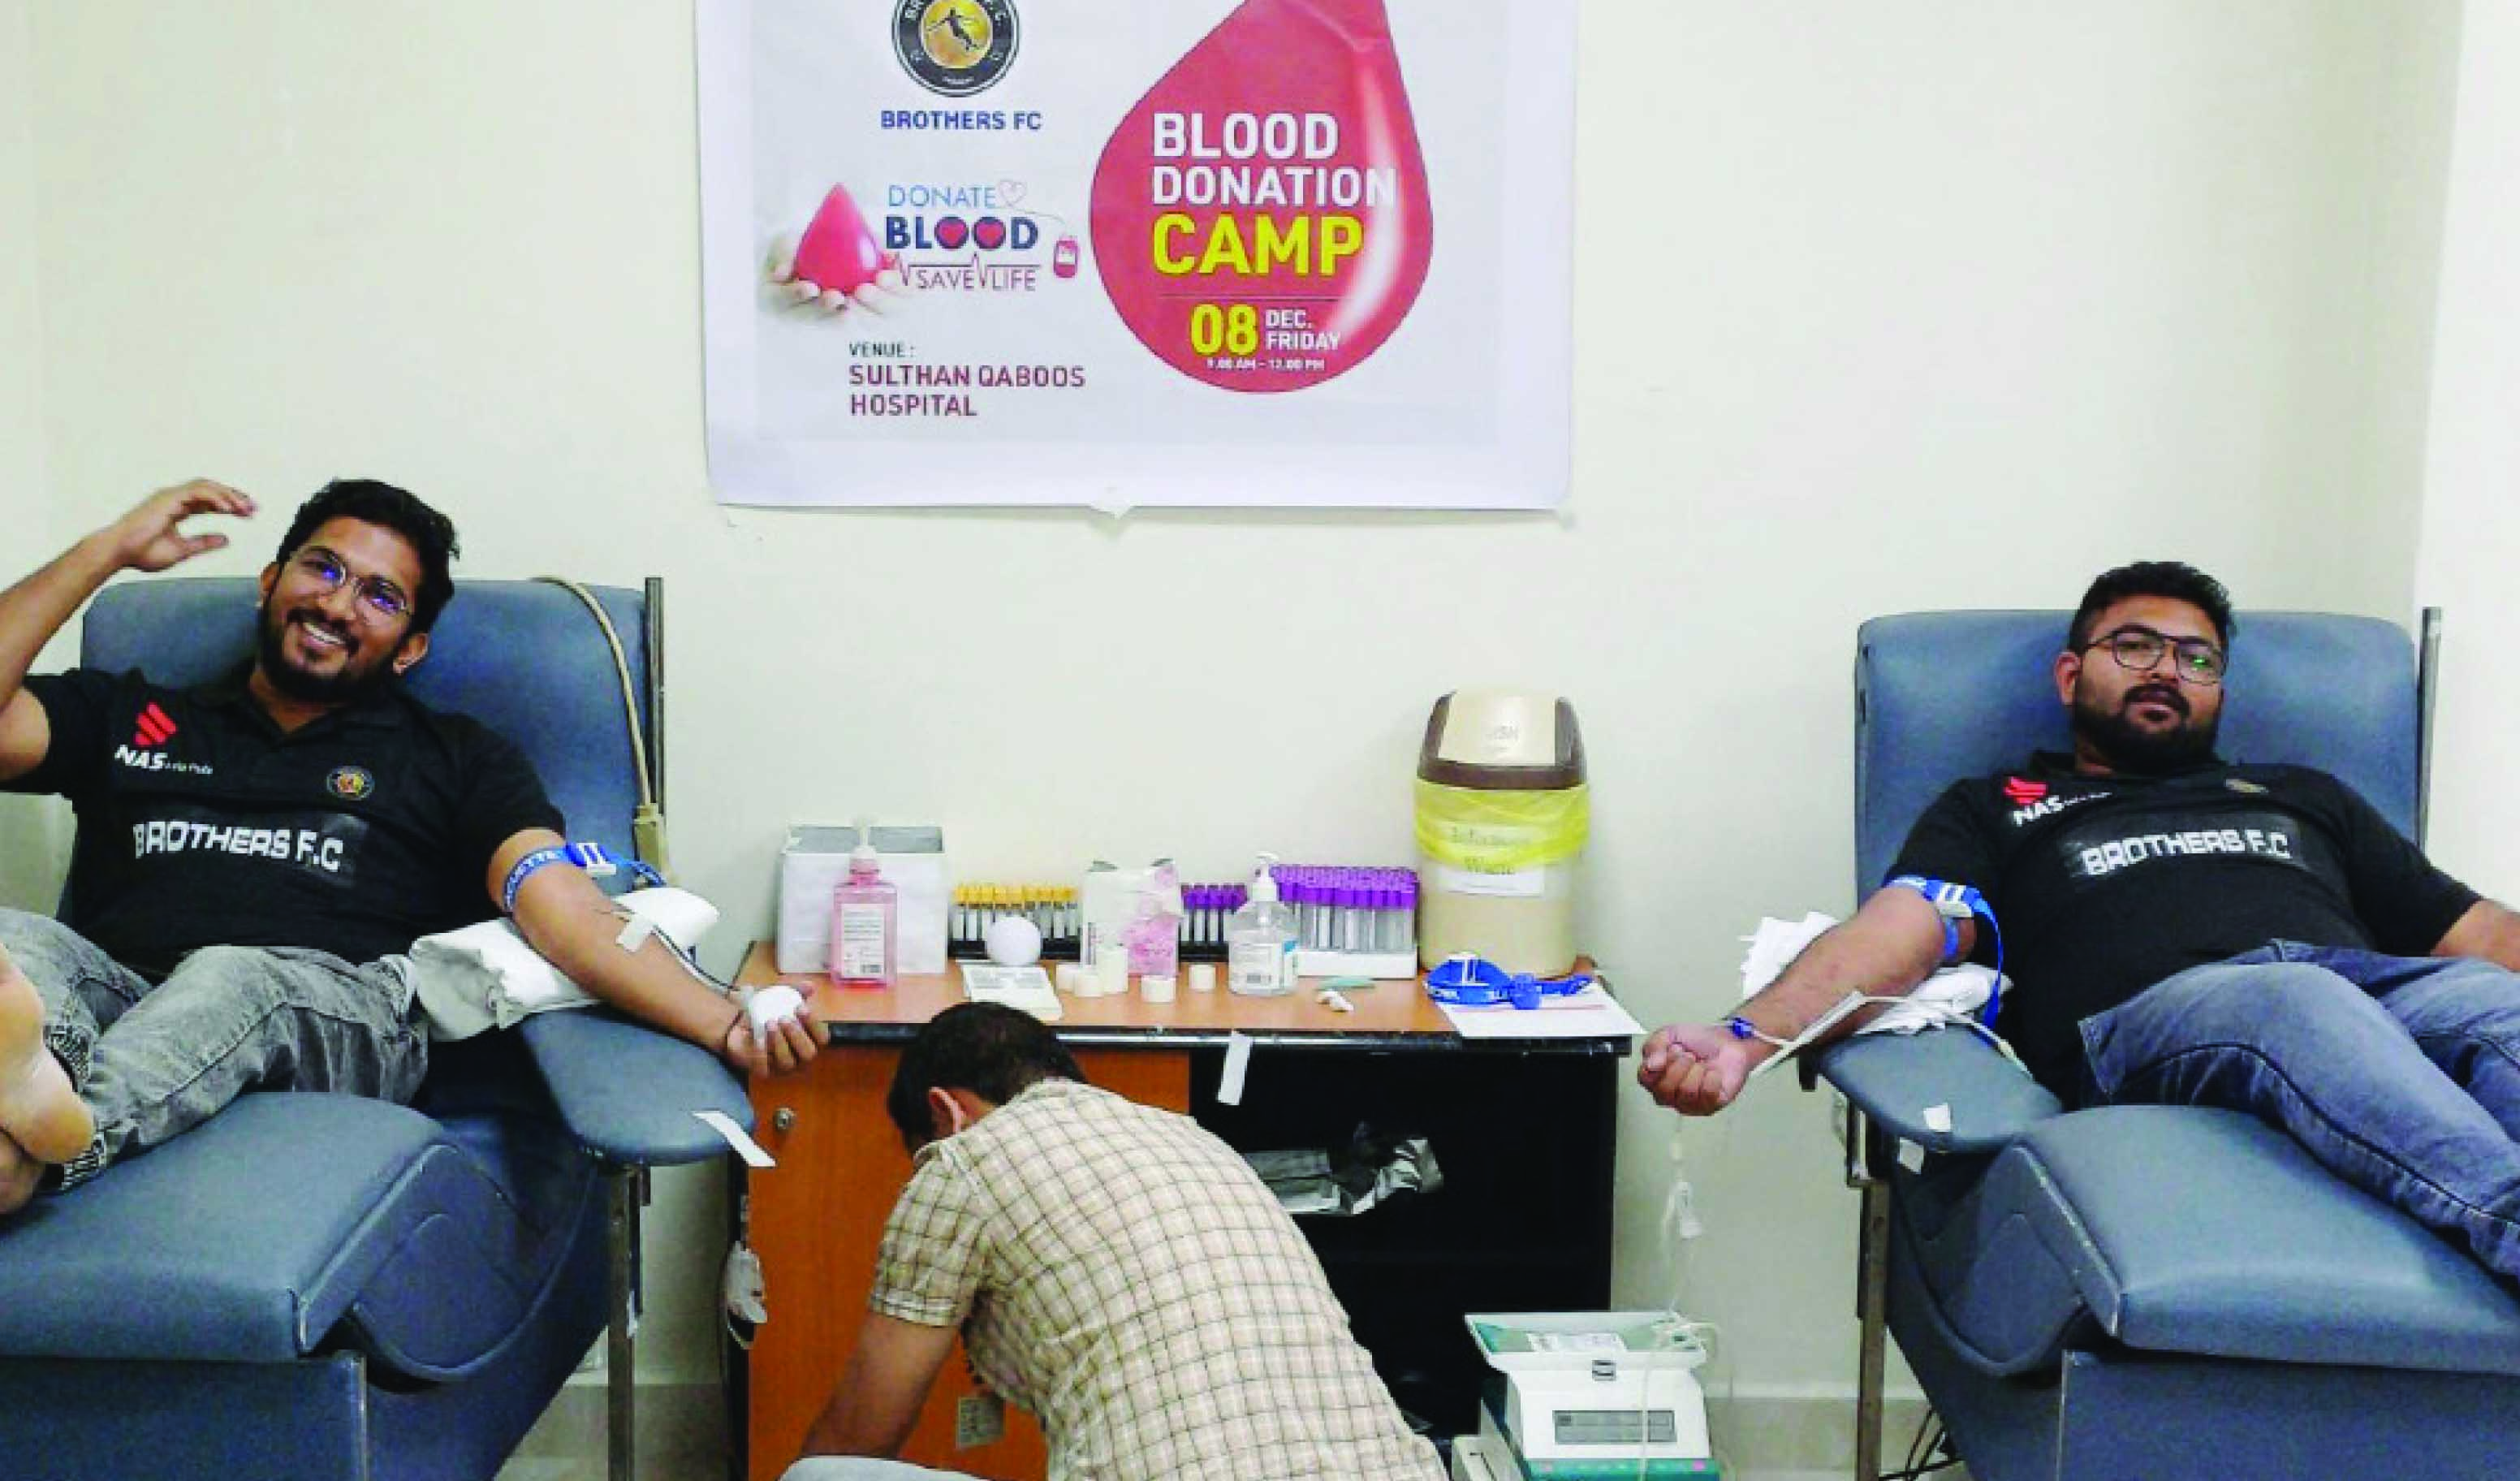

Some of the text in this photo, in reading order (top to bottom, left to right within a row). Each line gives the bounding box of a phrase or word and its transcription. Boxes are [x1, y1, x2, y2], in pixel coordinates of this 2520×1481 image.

[881, 110, 1042, 130] BROTHERS FC
[1153, 112, 1339, 160] BLOOD
[888, 184, 996, 208] DONATE
[1153, 166, 1396, 208] DONATION
[885, 215, 1039, 250] BLOOD
[1153, 212, 1365, 276] CAMP
[916, 269, 1037, 291] SAVE LIFE
[1191, 303, 1258, 355] 08
[1265, 309, 1313, 329] DEC.
[1265, 331, 1341, 350] FRIDAY
[848, 364, 1086, 387] SULTHAN QABOOS
[849, 393, 977, 416] HOSPITAL
[114, 744, 168, 772] NAS
[2013, 795, 2065, 827] NAS
[133, 820, 291, 859] BROTHERS
[2080, 829, 2246, 875] BROTHERS
